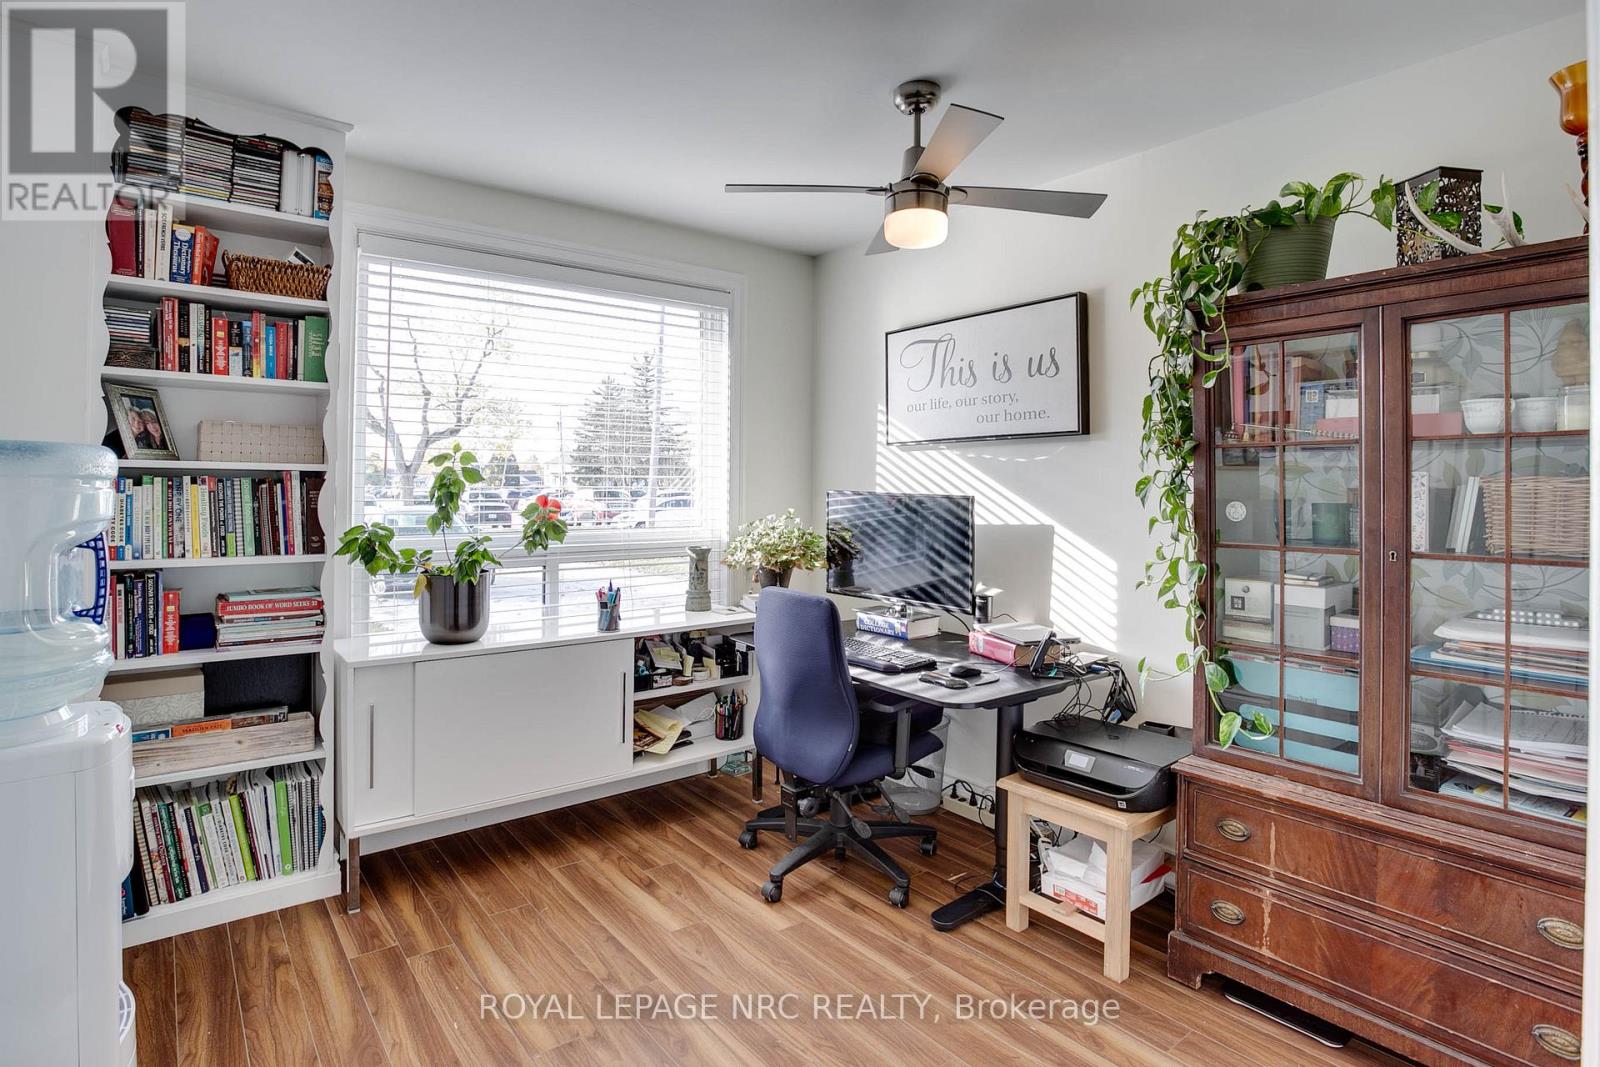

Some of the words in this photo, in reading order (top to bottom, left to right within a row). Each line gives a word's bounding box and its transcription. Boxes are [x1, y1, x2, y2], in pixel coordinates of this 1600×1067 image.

[172, 241, 181, 273] Thesaurus
[180, 241, 190, 276] Dictionary
[899, 333, 978, 393] This
[992, 352, 1013, 384] is
[1027, 346, 1061, 379] us
[906, 401, 927, 413] our
[955, 397, 979, 408] our
[981, 392, 1019, 406] story,
[976, 412, 1001, 424] our
[1004, 408, 1050, 422] home.
[200, 487, 208, 516] Healing
[175, 508, 183, 523] ONE
[201, 518, 209, 538] Foods
[248, 603, 265, 611] BOOK
[265, 602, 274, 610] OF
[274, 601, 293, 609] WORD
[860, 624, 895, 636] DICTIONARY
[864, 619, 889, 629] COLLEGE
[144, 805, 154, 833] CURRY
[217, 820, 226, 841] DIABETES
[153, 816, 161, 835] cooking
[157, 845, 167, 867] Quinoa
